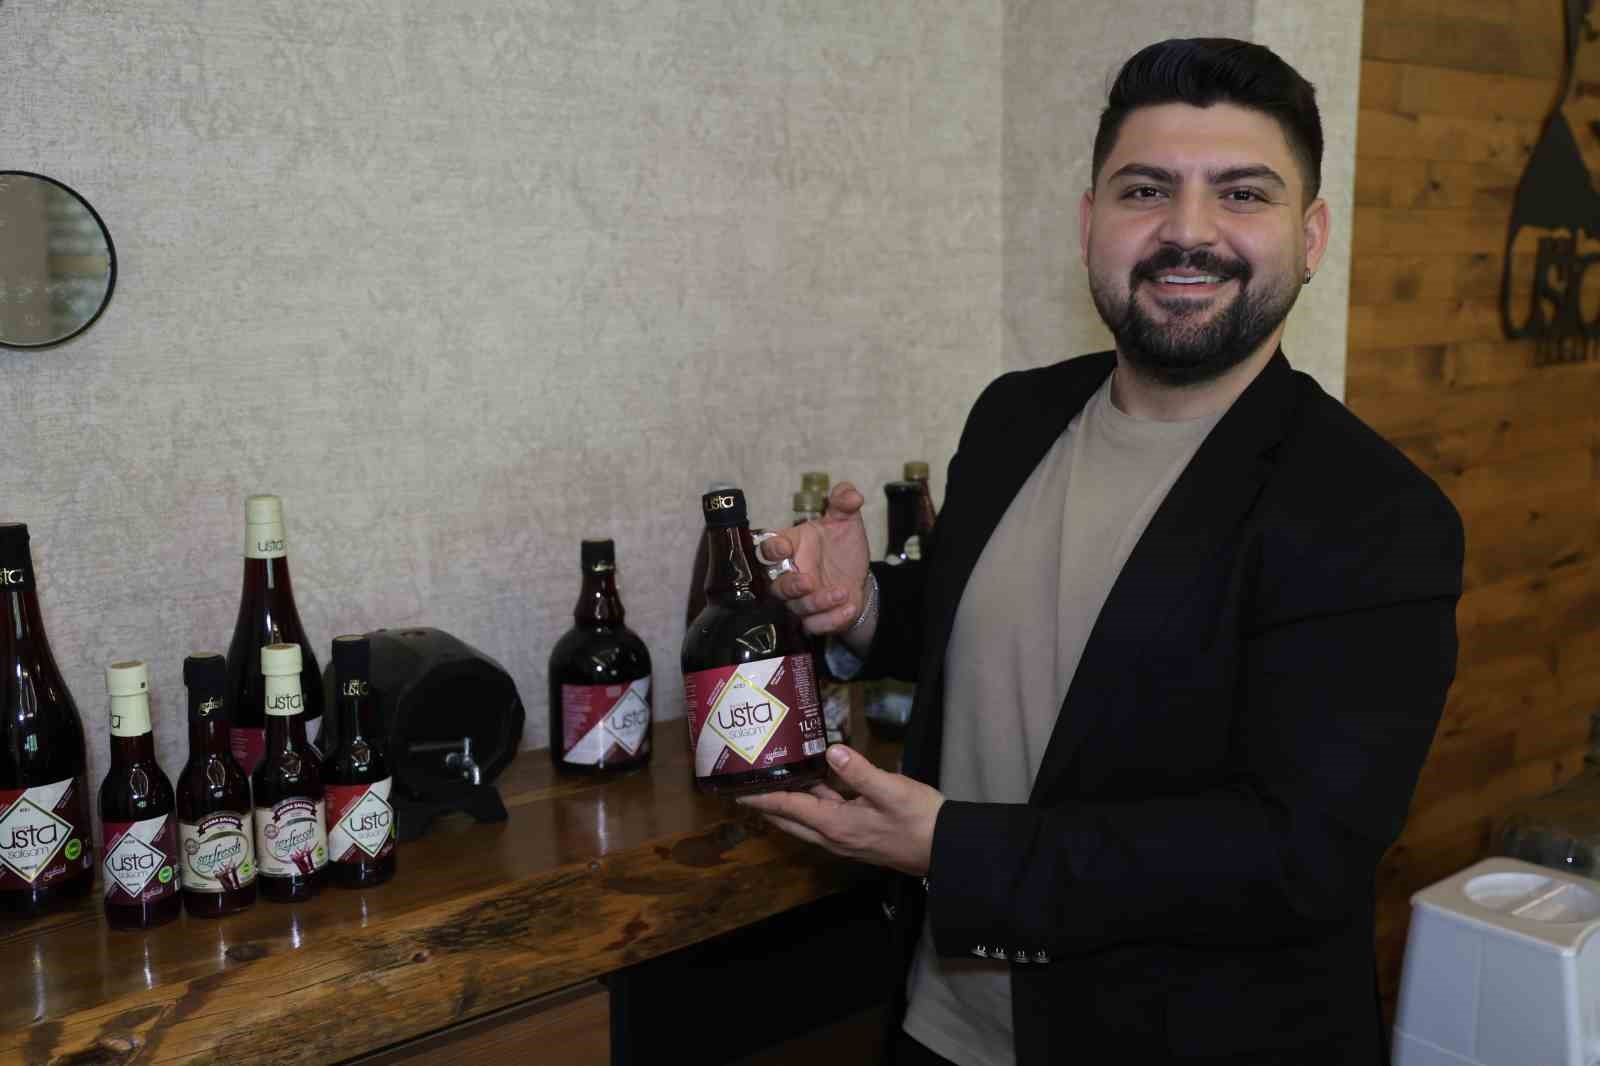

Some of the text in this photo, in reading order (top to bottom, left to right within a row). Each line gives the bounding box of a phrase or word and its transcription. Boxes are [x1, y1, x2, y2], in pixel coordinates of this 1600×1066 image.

[267, 695, 304, 709] usta
[718, 702, 773, 730] usta
[350, 811, 390, 831] usta
[111, 853, 154, 872] usta
